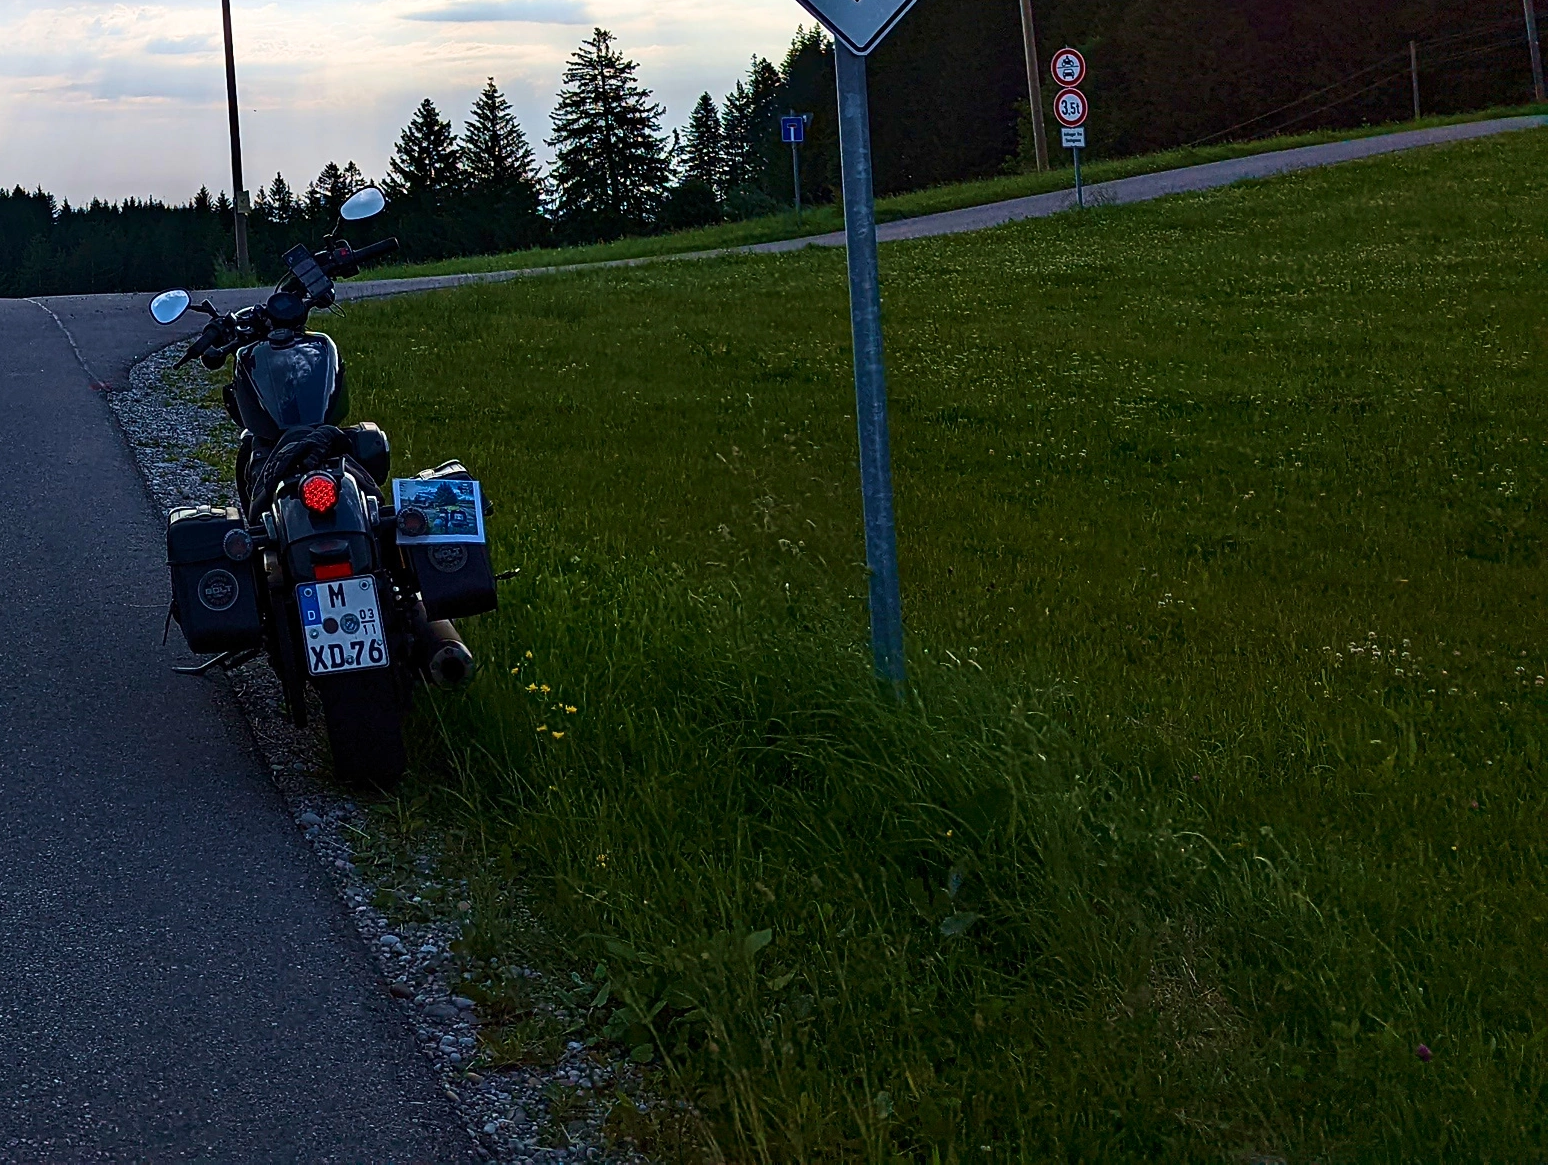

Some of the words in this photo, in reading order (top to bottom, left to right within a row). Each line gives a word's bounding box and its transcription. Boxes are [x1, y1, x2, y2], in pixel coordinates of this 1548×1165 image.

[328, 583, 346, 608] M
[307, 610, 316, 621] D
[359, 608, 374, 620] 03
[363, 623, 376, 635] 11
